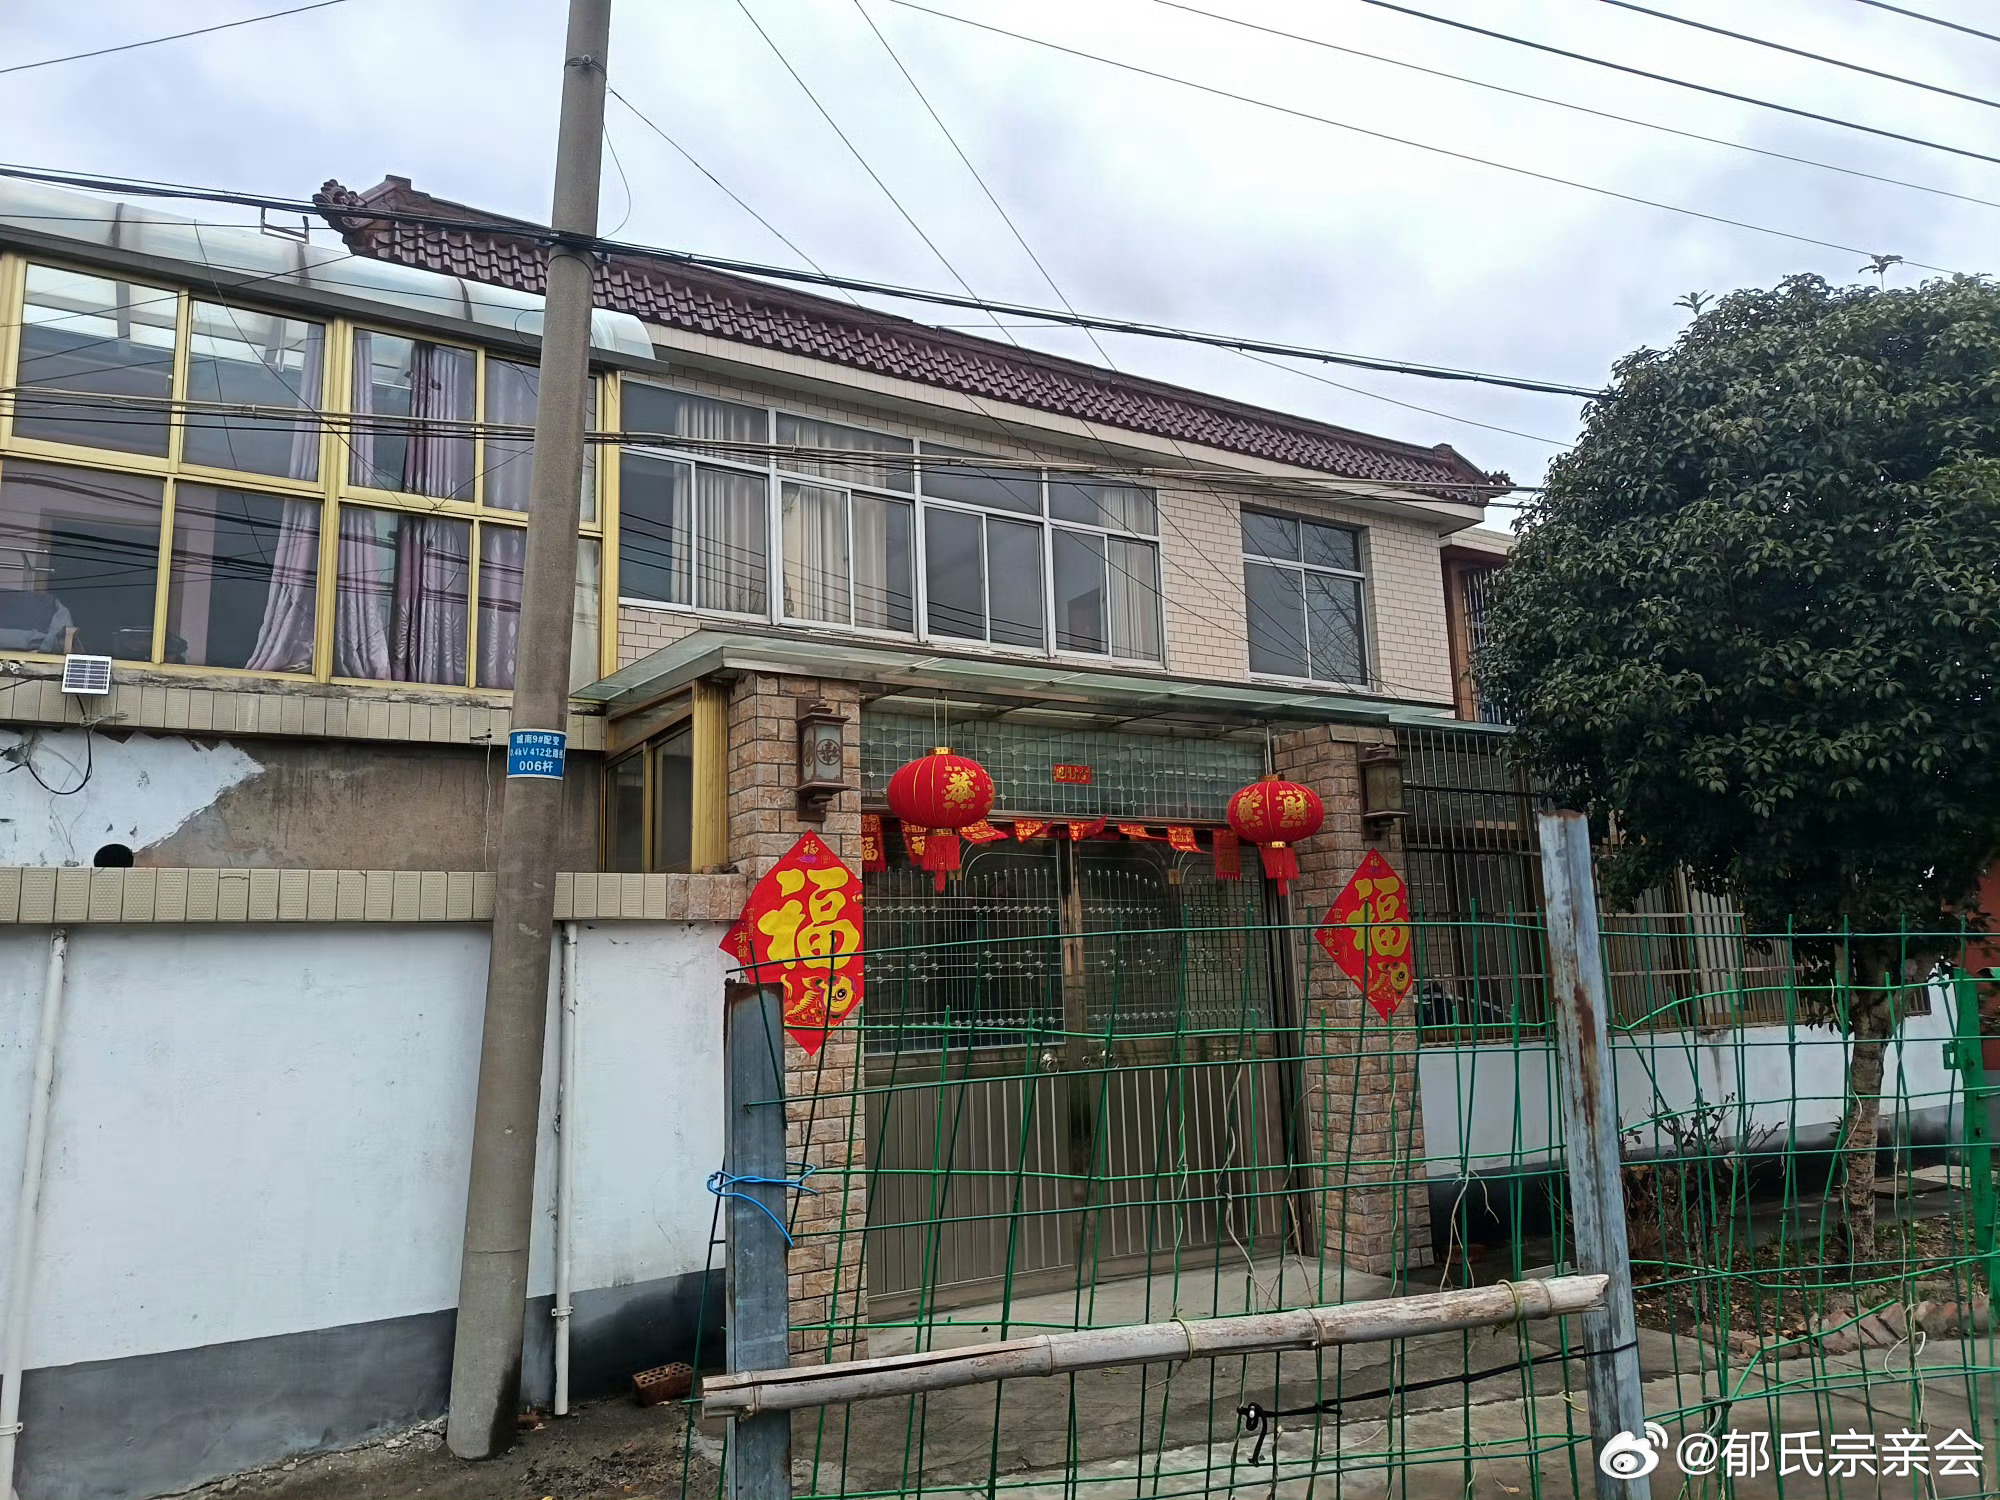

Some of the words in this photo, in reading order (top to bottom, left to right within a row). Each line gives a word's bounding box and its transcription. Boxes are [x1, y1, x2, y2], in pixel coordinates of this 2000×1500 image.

[519, 760, 553, 773] 006杆
[757, 867, 860, 970] 福
[1347, 876, 1410, 957] 福
